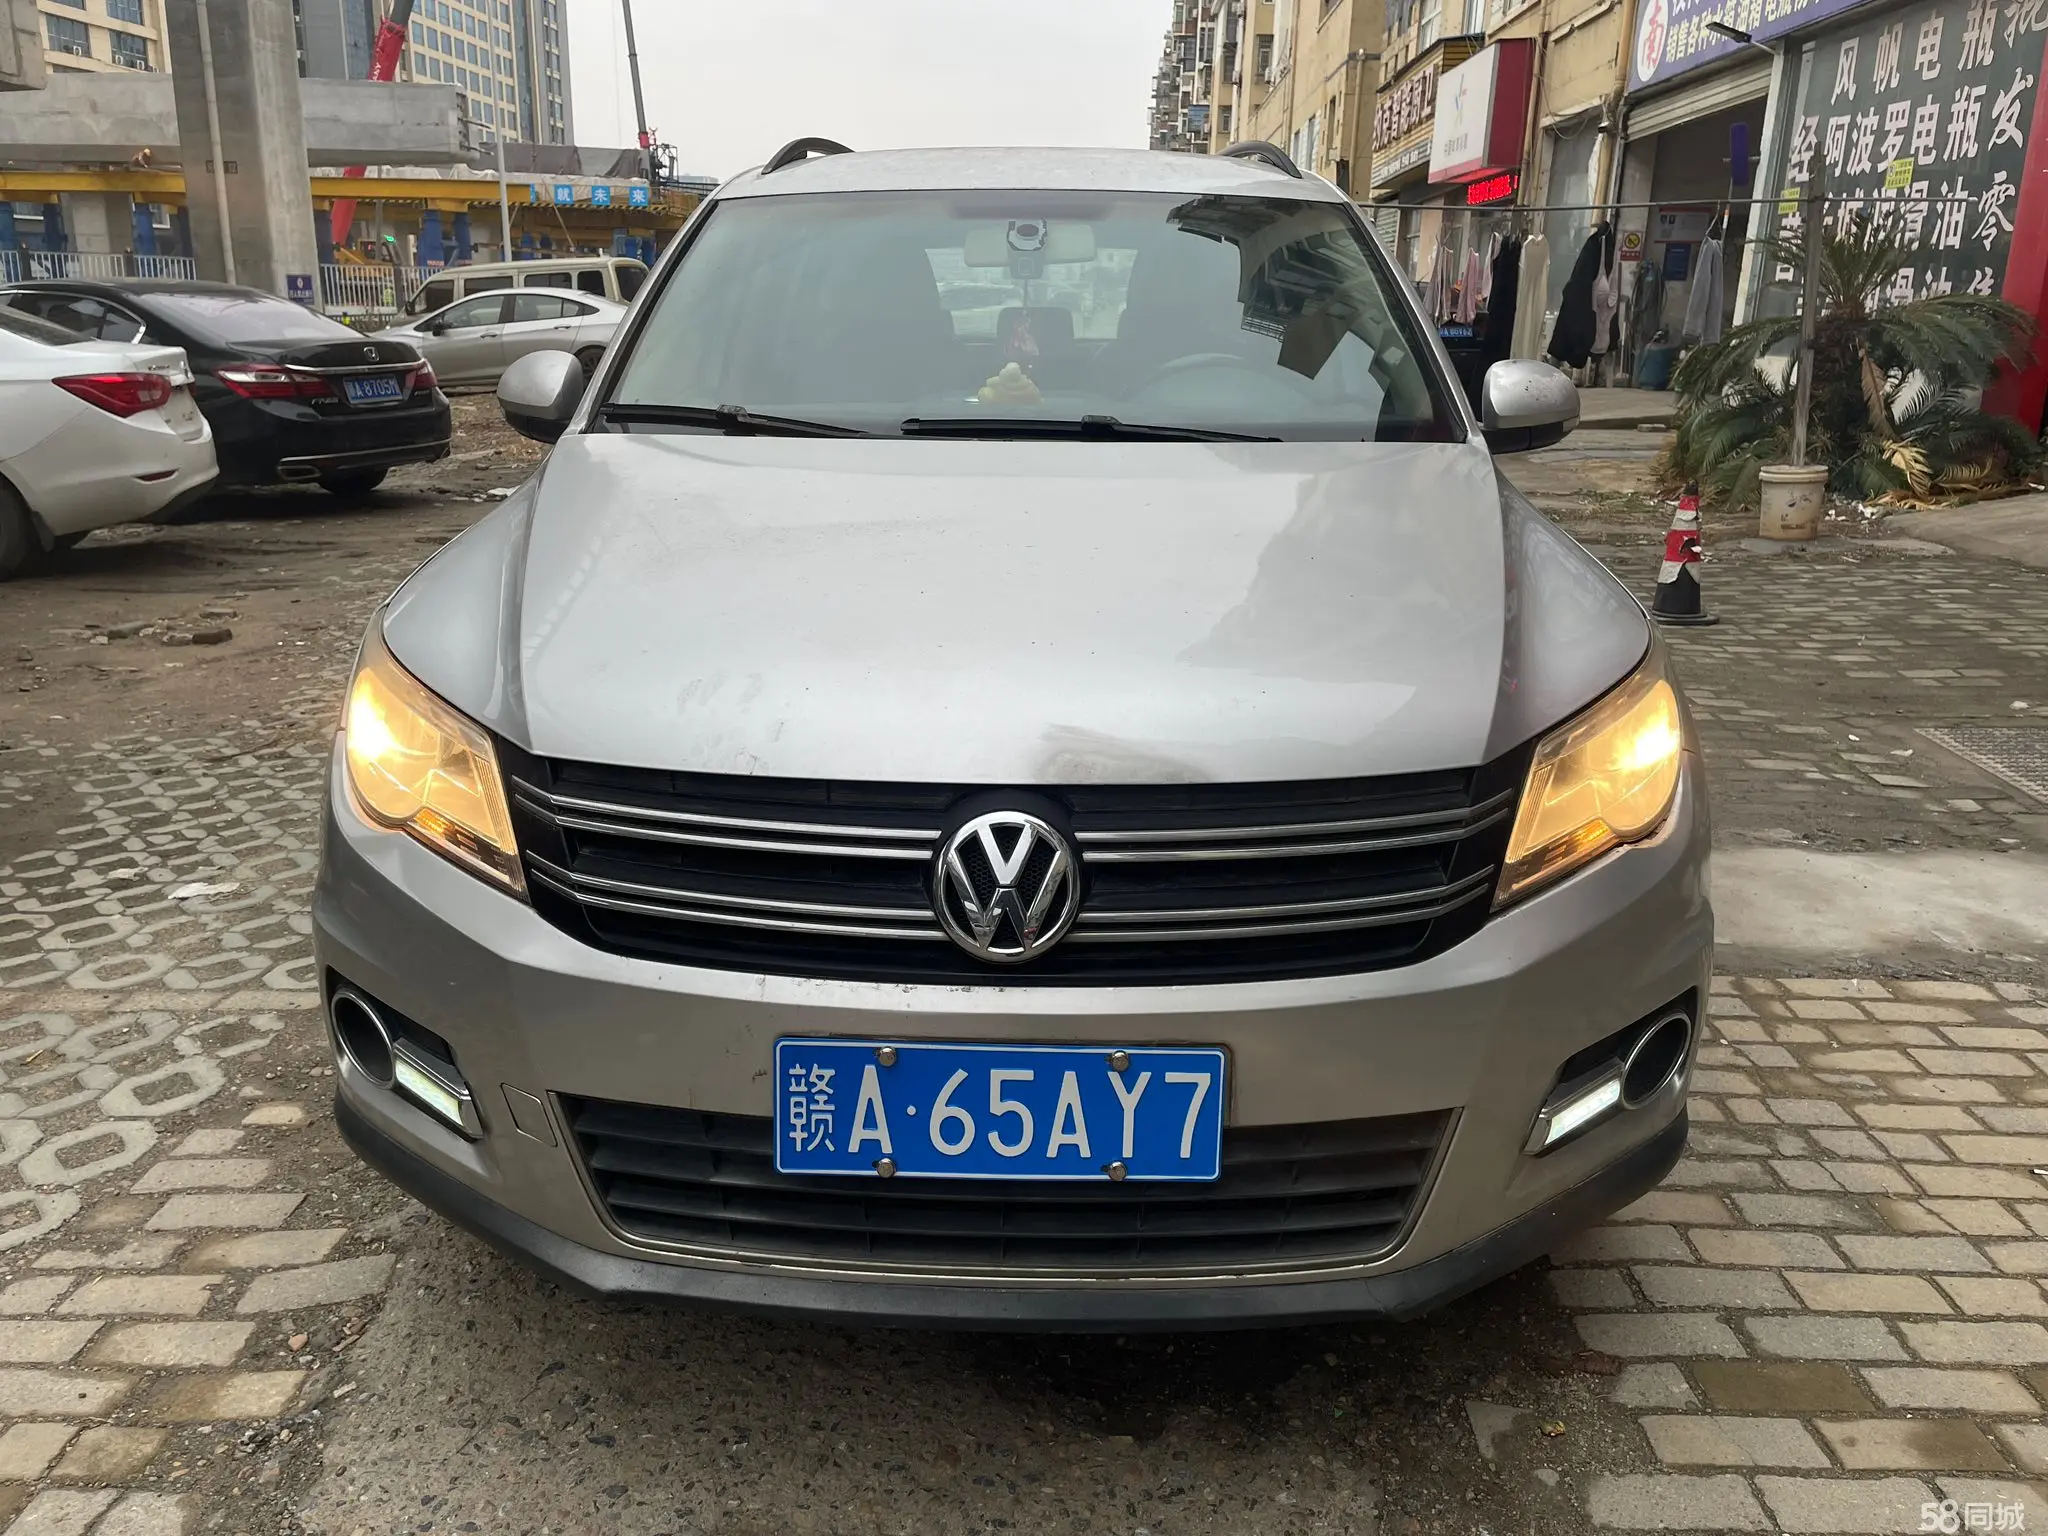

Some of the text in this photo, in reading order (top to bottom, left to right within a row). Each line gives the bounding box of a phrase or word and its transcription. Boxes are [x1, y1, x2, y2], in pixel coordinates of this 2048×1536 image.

[1831, 0, 1998, 106] 风帆电瓶
[1824, 85, 1987, 178] 阿波罗电瓶
[788, 1062, 1212, 1160] 赣A·65AY7
